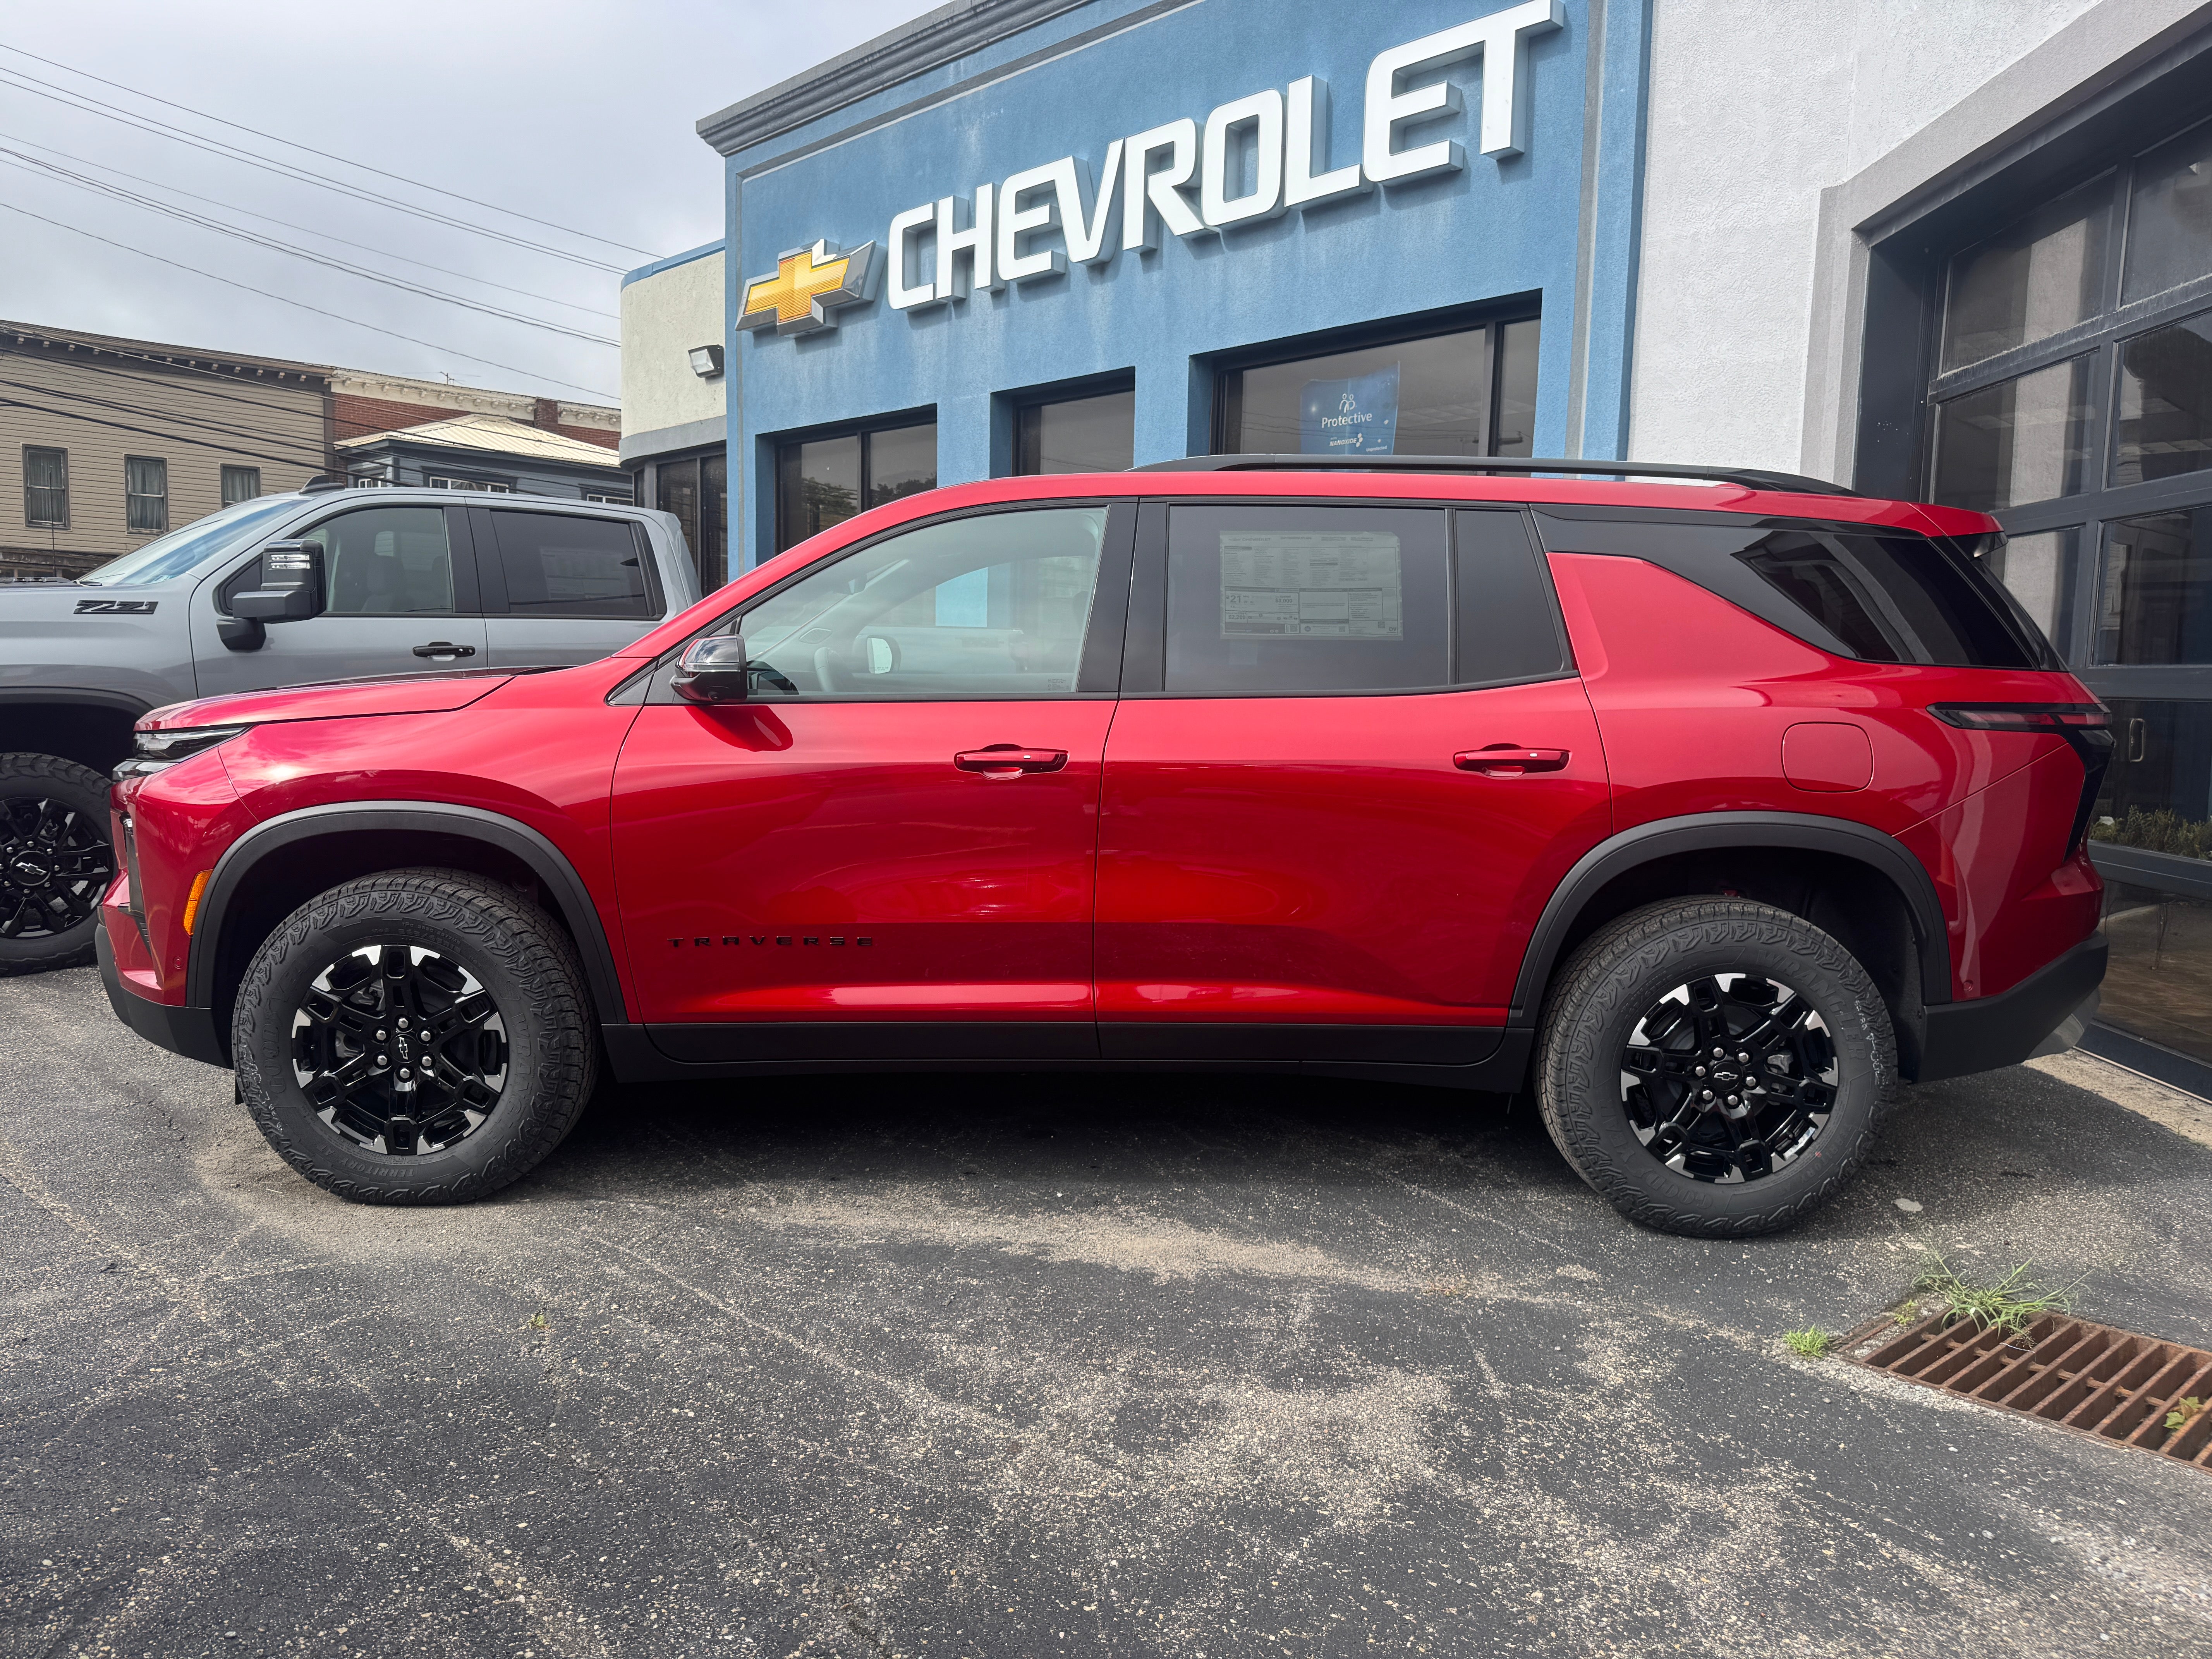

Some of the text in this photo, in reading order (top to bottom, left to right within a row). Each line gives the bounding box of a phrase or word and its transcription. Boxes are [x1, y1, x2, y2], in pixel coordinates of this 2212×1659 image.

[888, 0, 1564, 312] CHEVROLET
[1321, 412, 1372, 428] Protective
[1329, 438, 1357, 447] NANOXIDE
[1230, 595, 1241, 603] 21
[73, 600, 158, 615] Z71
[666, 936, 865, 948] TRAVERSE
[1755, 948, 1868, 1060] WRANGLER
[338, 1158, 415, 1177] TERRITORY
